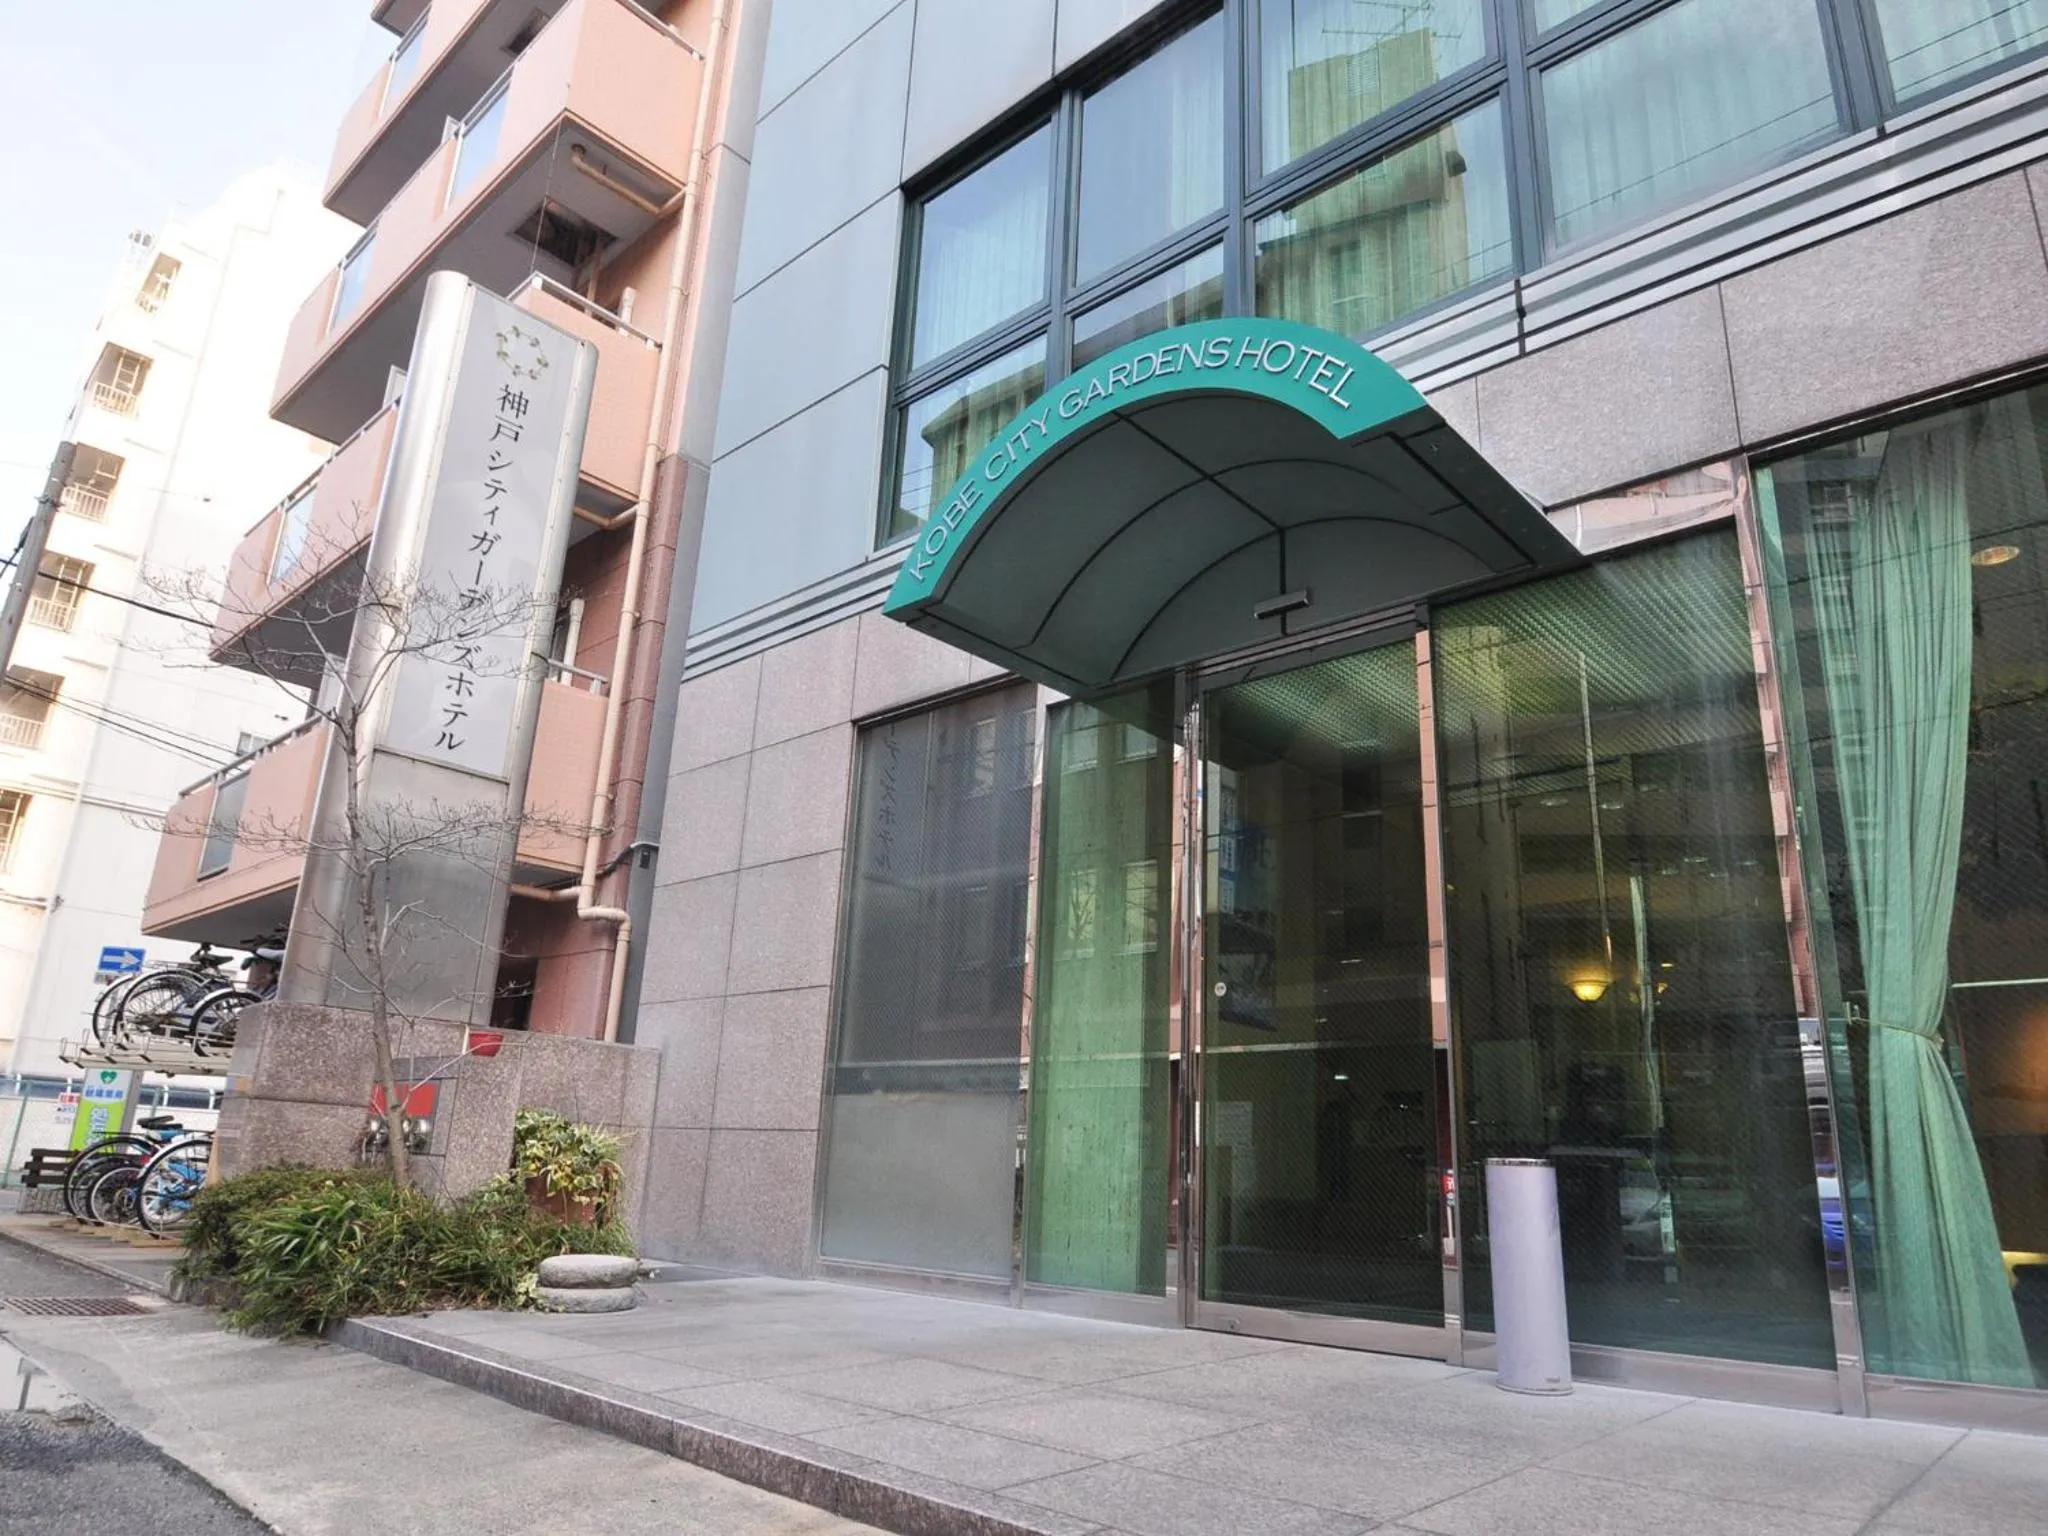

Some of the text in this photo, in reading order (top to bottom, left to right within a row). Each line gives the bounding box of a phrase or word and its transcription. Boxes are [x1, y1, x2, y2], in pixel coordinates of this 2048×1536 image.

[434, 383, 530, 750] 神戸シティガーデンズホテル
[909, 336, 1355, 581] KOBE CITY GARDENS HOTEL
